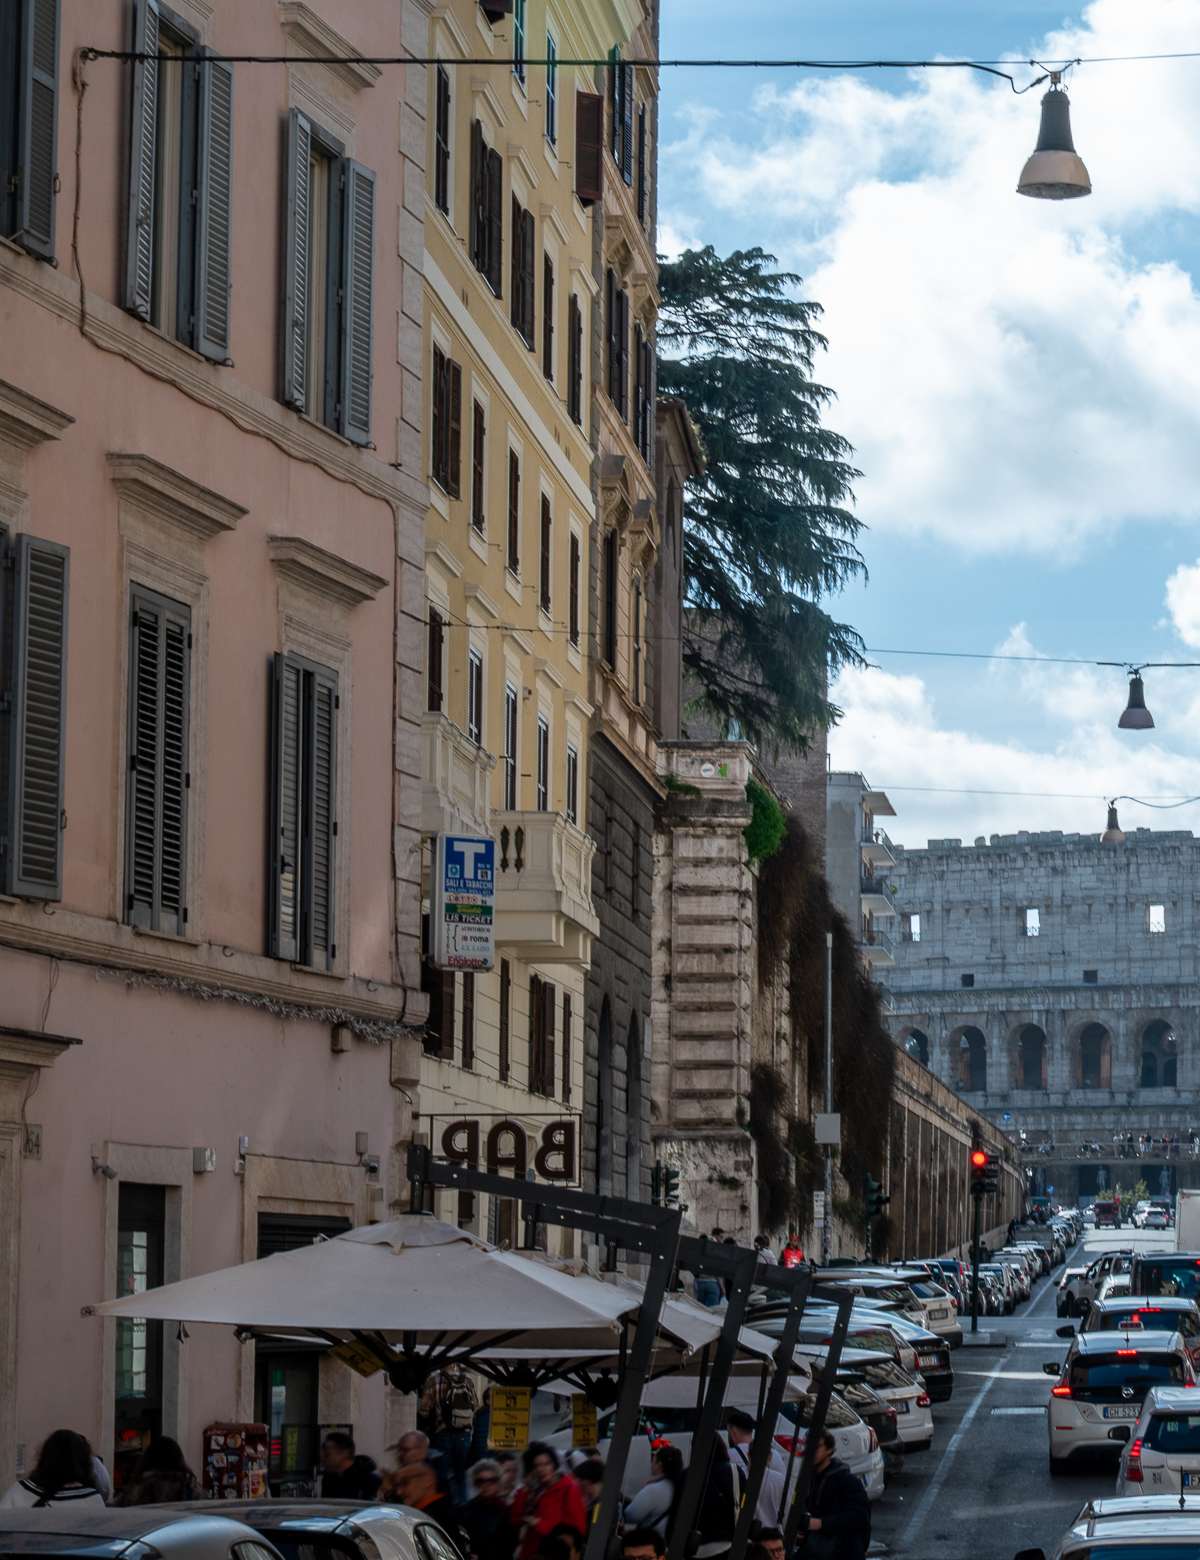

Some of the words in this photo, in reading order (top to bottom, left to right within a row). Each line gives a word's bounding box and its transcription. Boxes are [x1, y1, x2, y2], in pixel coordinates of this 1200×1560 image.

[453, 841, 486, 879] T
[446, 878, 459, 887] SALI
[460, 879, 464, 887] E
[465, 880, 493, 889] TABACCHI
[462, 915, 492, 924] TICKET
